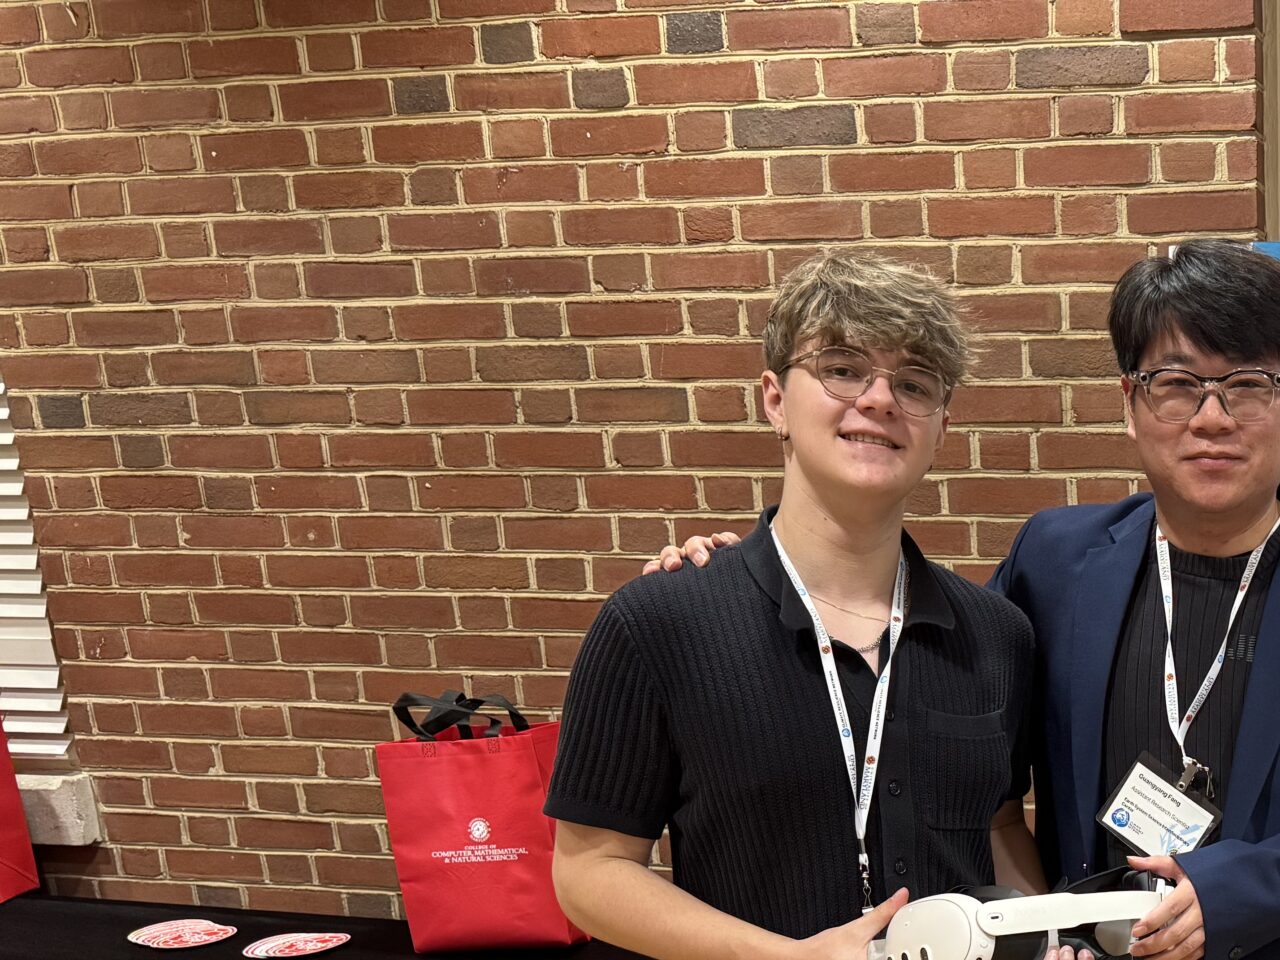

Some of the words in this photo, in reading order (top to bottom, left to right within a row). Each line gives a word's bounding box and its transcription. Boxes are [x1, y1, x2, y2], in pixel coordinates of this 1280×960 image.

[431, 850, 474, 858] COMPUTER,
[474, 847, 529, 856] MATHEMATICAL,
[451, 855, 485, 863] NATURAL
[485, 854, 518, 862] SCIENCES
